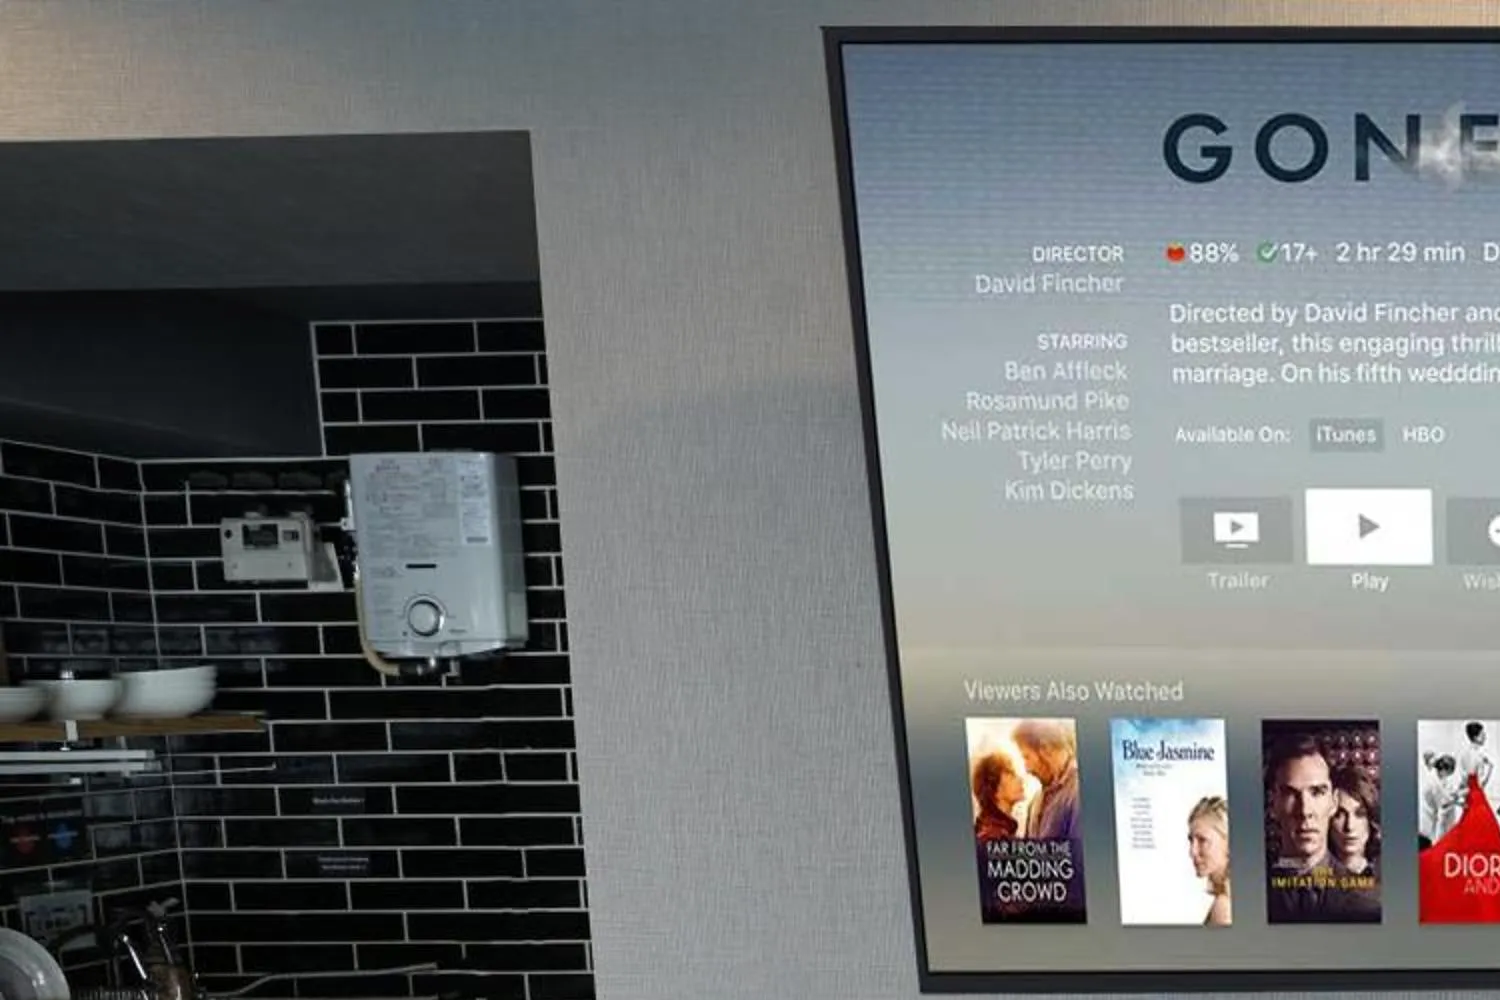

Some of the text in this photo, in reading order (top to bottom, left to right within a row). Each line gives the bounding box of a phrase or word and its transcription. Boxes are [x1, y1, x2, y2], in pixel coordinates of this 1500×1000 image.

[1163, 112, 1500, 183] GONE
[1032, 245, 1124, 263] DIRECTOR
[1190, 242, 1239, 263] 88%
[1281, 242, 1318, 262] 17+
[1336, 242, 1350, 262] 2
[1357, 242, 1381, 262] hr
[1387, 242, 1417, 262] 29
[1424, 242, 1466, 262] min
[975, 273, 1124, 293] David Fincher
[1170, 302, 1265, 323] Directed
[1272, 302, 1298, 327] by
[1304, 302, 1368, 323] David
[1375, 302, 1460, 323] Fincher
[1037, 333, 1128, 350] STARRING
[1171, 333, 1285, 355] bestseller,
[1292, 332, 1333, 353] this
[1339, 333, 1445, 357] engaging
[1004, 360, 1128, 381] Ben Affleck
[1172, 363, 1275, 387] marriage.
[1281, 363, 1312, 383] On
[1318, 362, 1351, 383] his
[1356, 362, 1401, 383] fifth
[966, 390, 1130, 411] Rosamund Pike
[941, 420, 1133, 441] Neil Patrick Harris
[1175, 425, 1446, 443] Available On: iTunes HBO
[1017, 451, 1132, 475] Tyler Perry
[1005, 479, 1135, 500] Kim Dickens
[1208, 572, 1270, 590] Trailer
[1351, 572, 1389, 593] Play
[963, 679, 1185, 701] Viewers Also Watched
[1122, 739, 1215, 761] Blue Jasmine
[987, 858, 1075, 879] MADDING
[997, 881, 1067, 902] CROWD
[1463, 876, 1500, 896] AND
